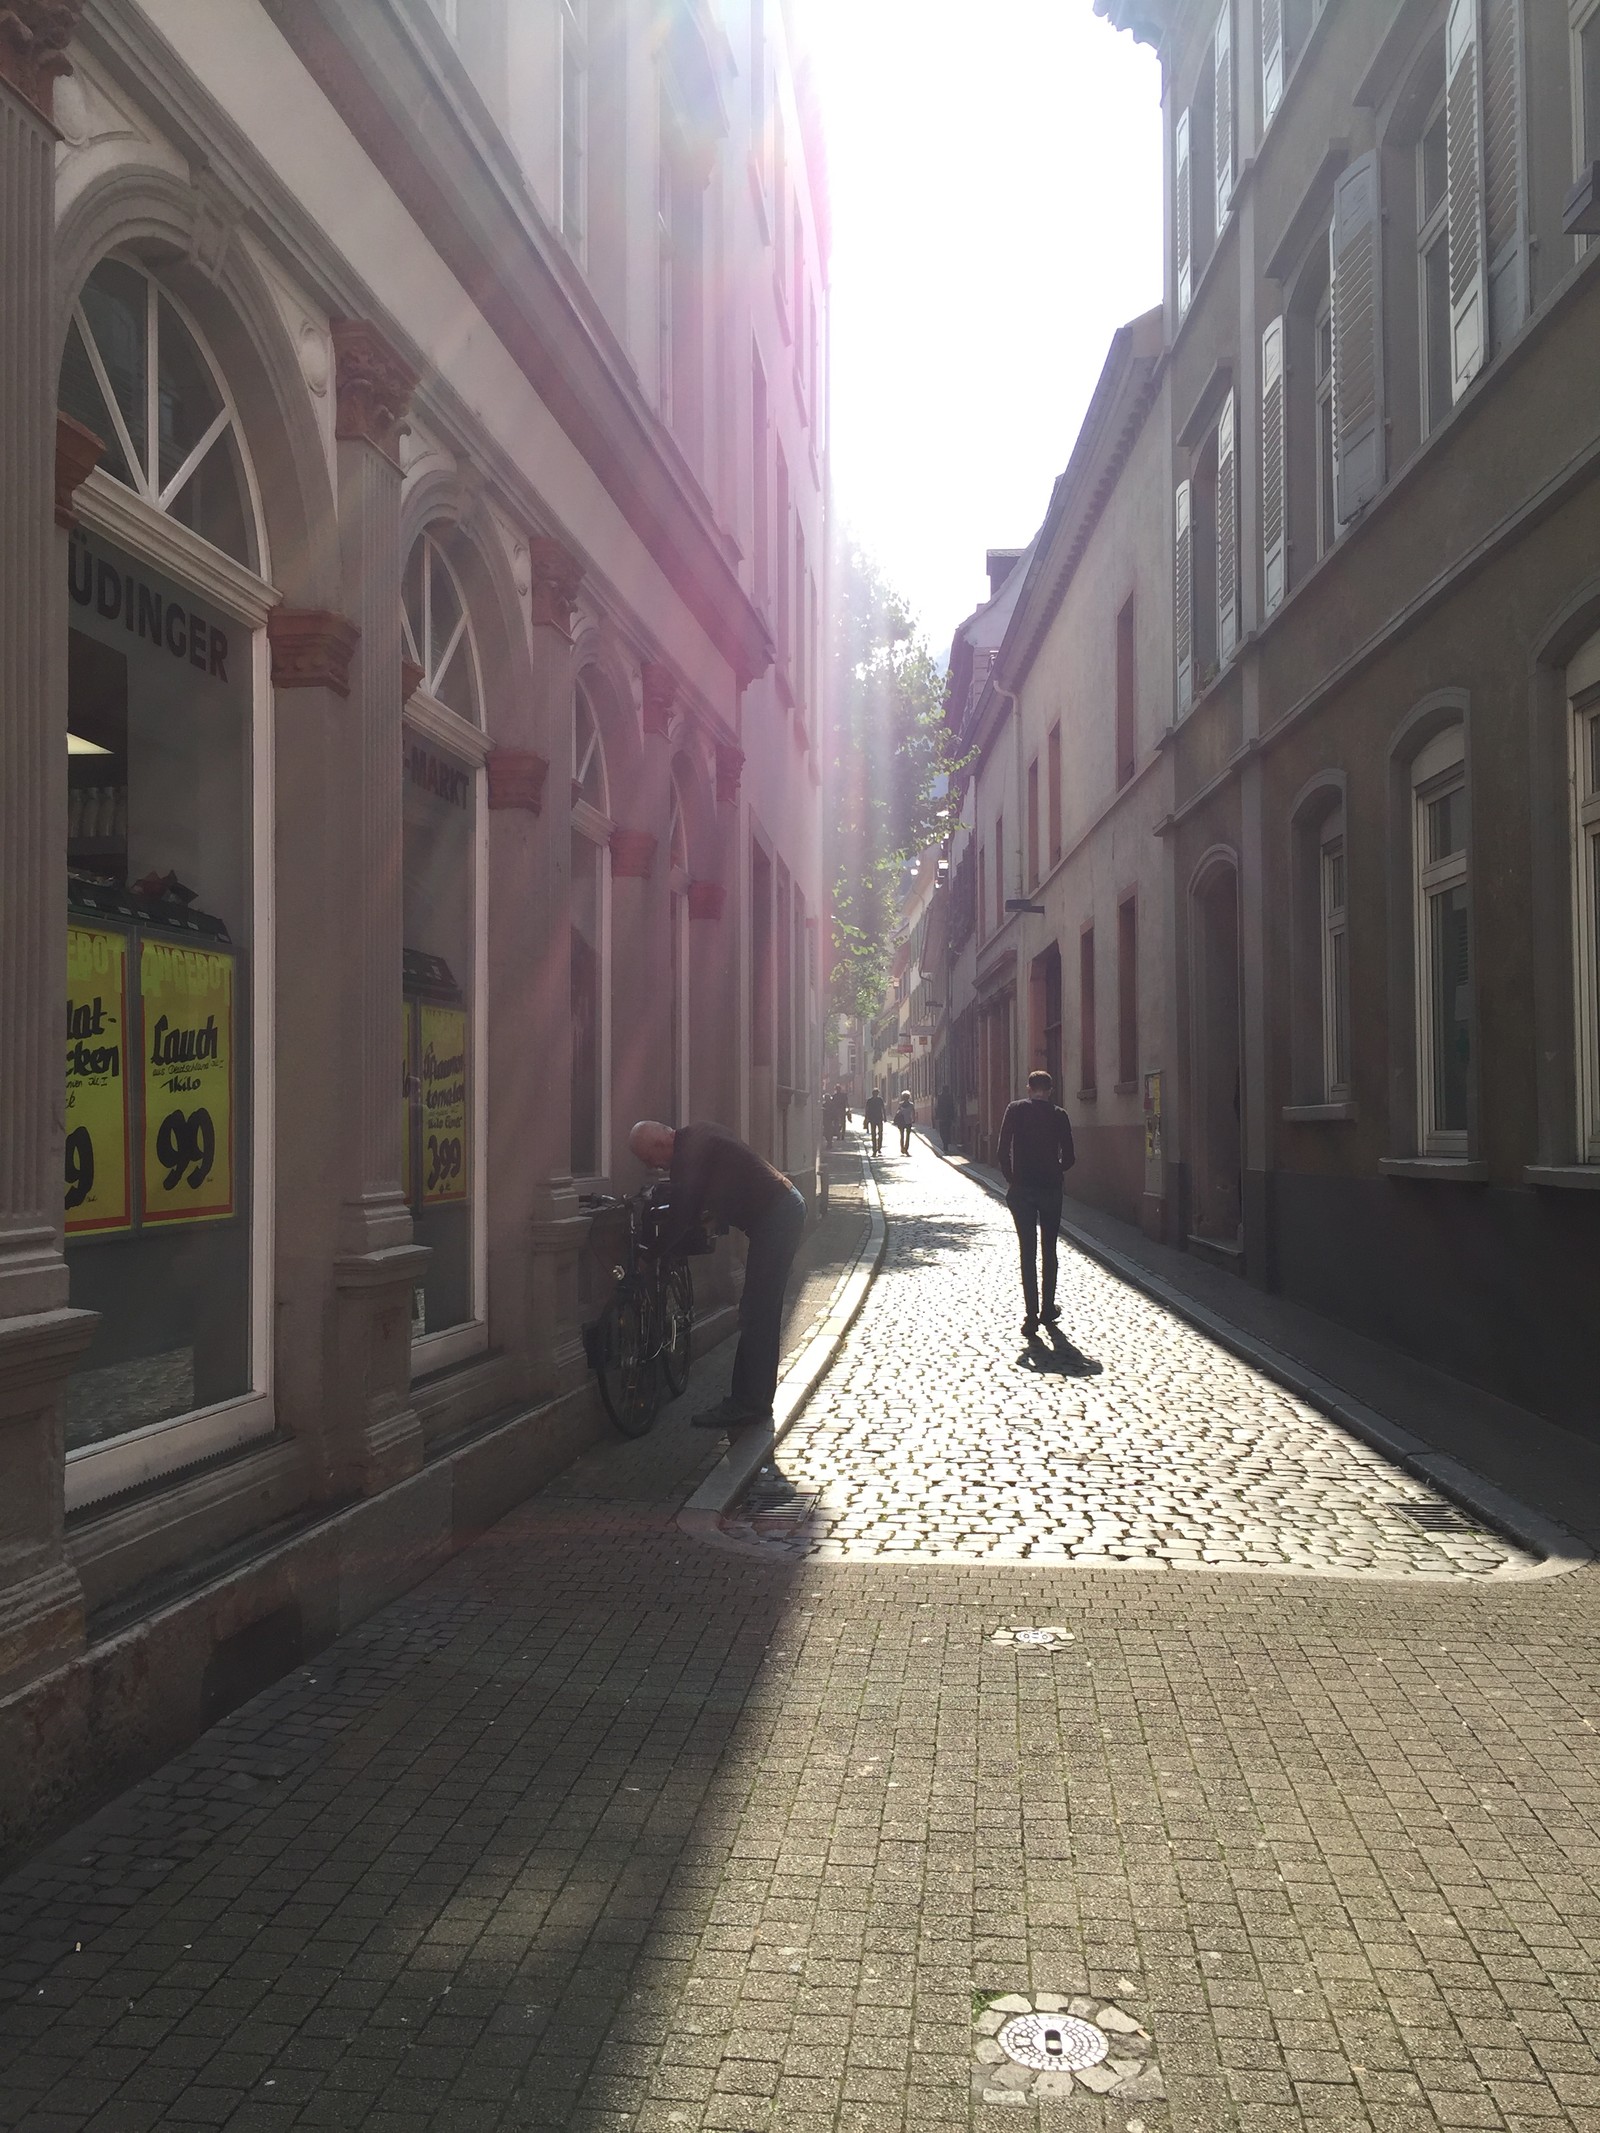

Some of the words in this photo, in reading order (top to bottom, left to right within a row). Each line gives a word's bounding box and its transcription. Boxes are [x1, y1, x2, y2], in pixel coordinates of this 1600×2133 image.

[68, 528, 229, 684] ÜDINGER
[403, 740, 470, 810] -MARKT
[141, 944, 233, 1006] ANGEBOT
[150, 1014, 218, 1066] Lauch
[156, 1108, 215, 1191] 99
